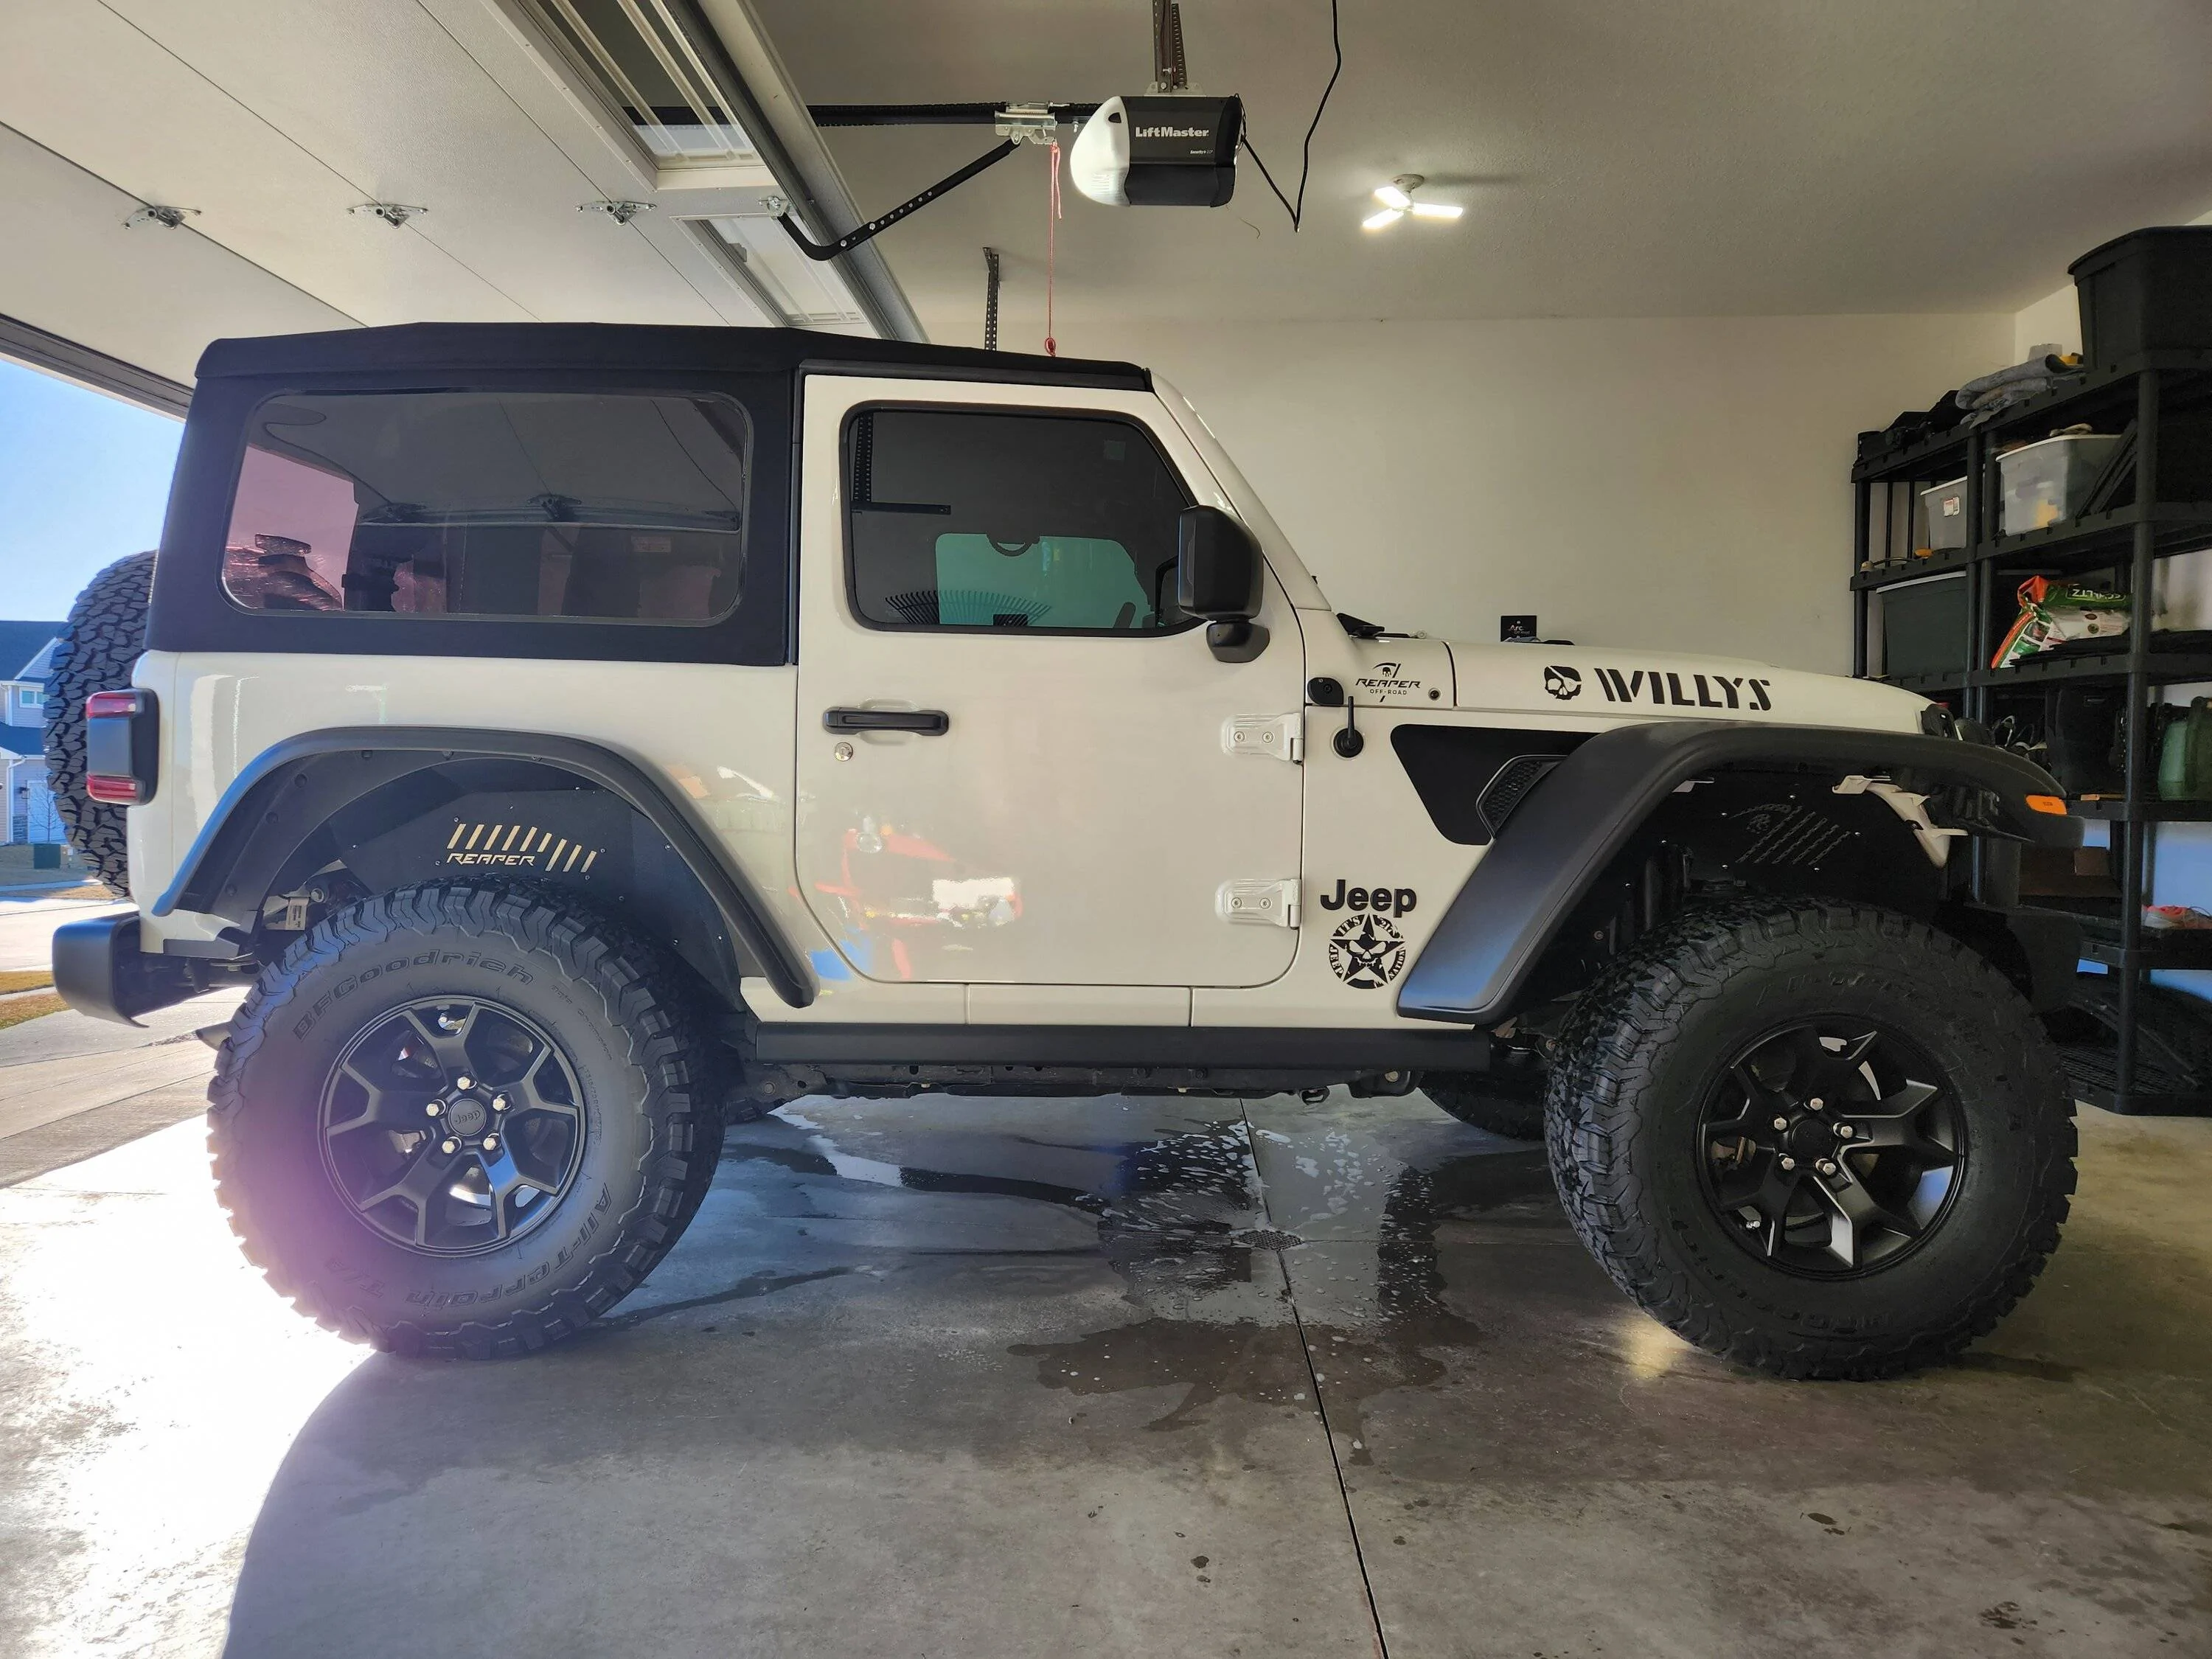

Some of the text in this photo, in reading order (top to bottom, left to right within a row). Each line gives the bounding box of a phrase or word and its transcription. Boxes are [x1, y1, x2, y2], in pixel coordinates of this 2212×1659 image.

[1135, 126, 1209, 138] LiftMaster
[1355, 678, 1421, 688] REAPER
[1593, 667, 1772, 711] WILLYS
[446, 852, 535, 866] REAPER
[1320, 879, 1417, 918] Jeep
[1329, 946, 1405, 980] JEEP NATION
[293, 948, 535, 1042] BFGoodrich
[454, 1110, 481, 1124] Jeep
